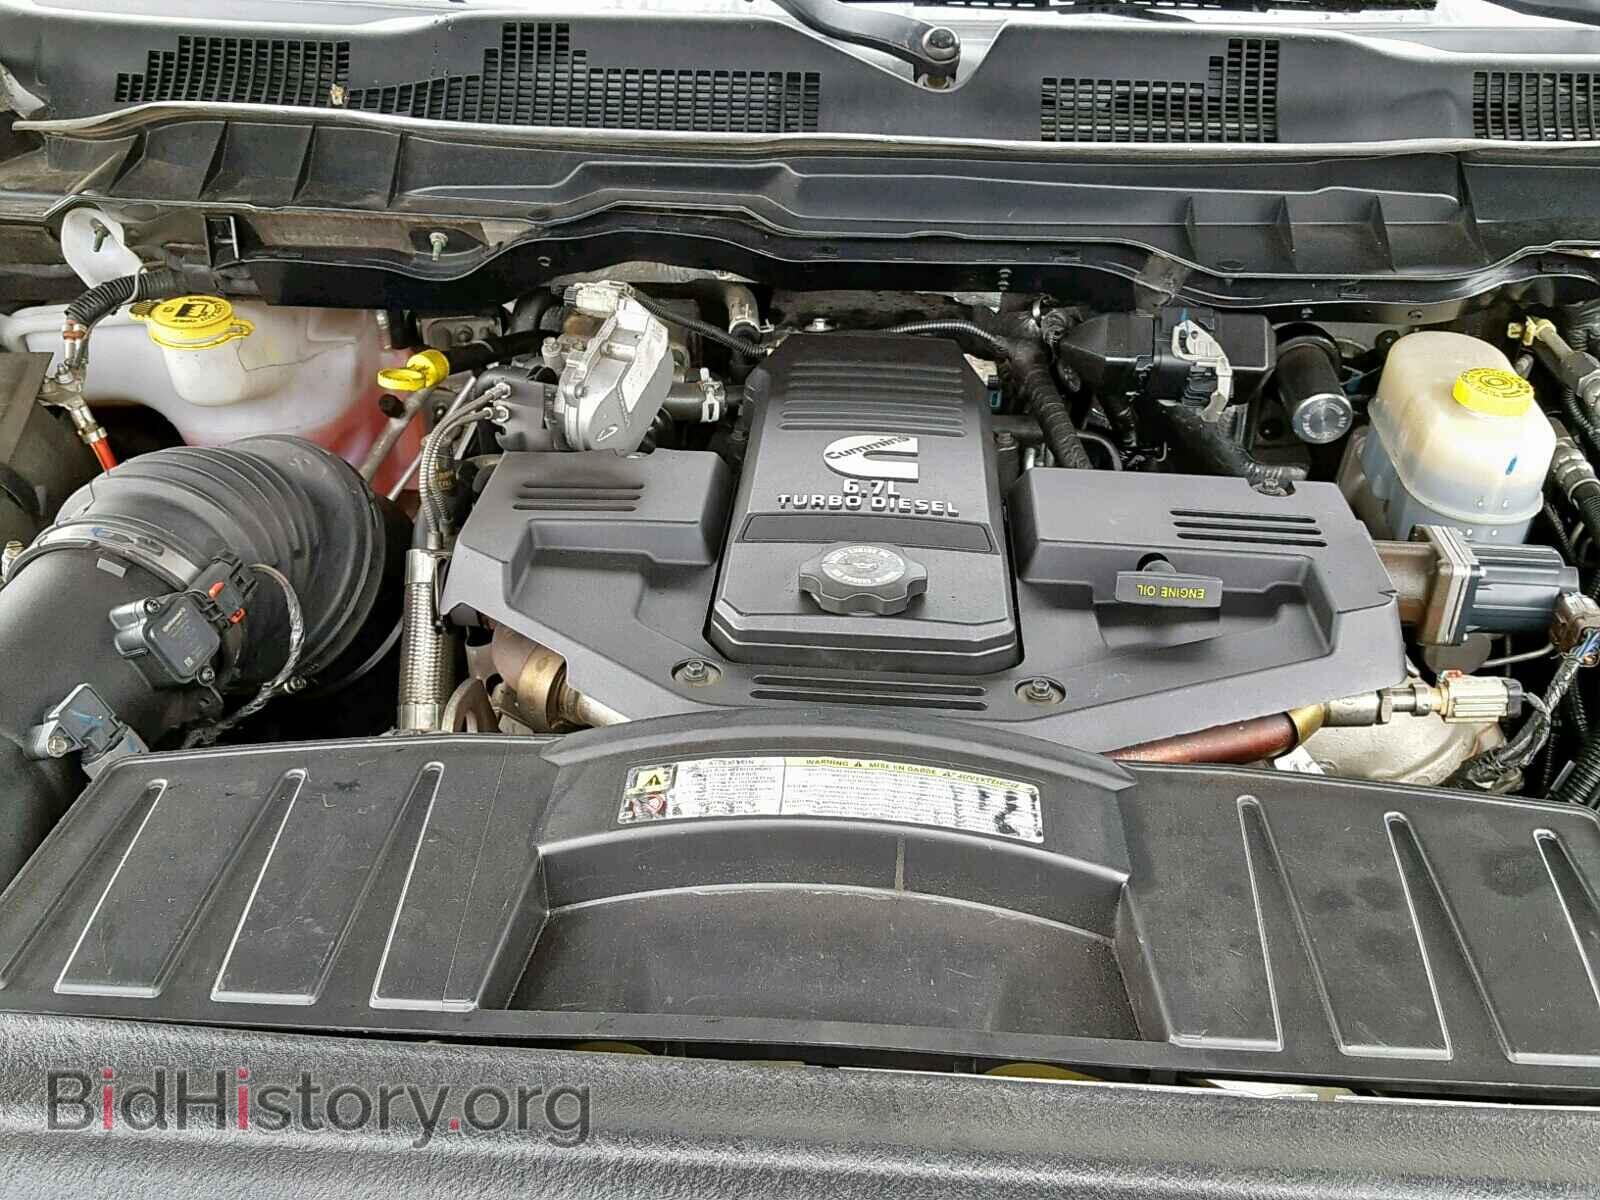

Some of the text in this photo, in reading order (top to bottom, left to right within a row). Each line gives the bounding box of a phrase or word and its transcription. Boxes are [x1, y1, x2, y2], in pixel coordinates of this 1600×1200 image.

[825, 434, 912, 460] Cummins
[843, 479, 900, 498] 6.7L
[777, 494, 959, 516] TURBO DIESEL
[1136, 584, 1205, 599] ENGINE OIL
[806, 758, 849, 768] WARNING
